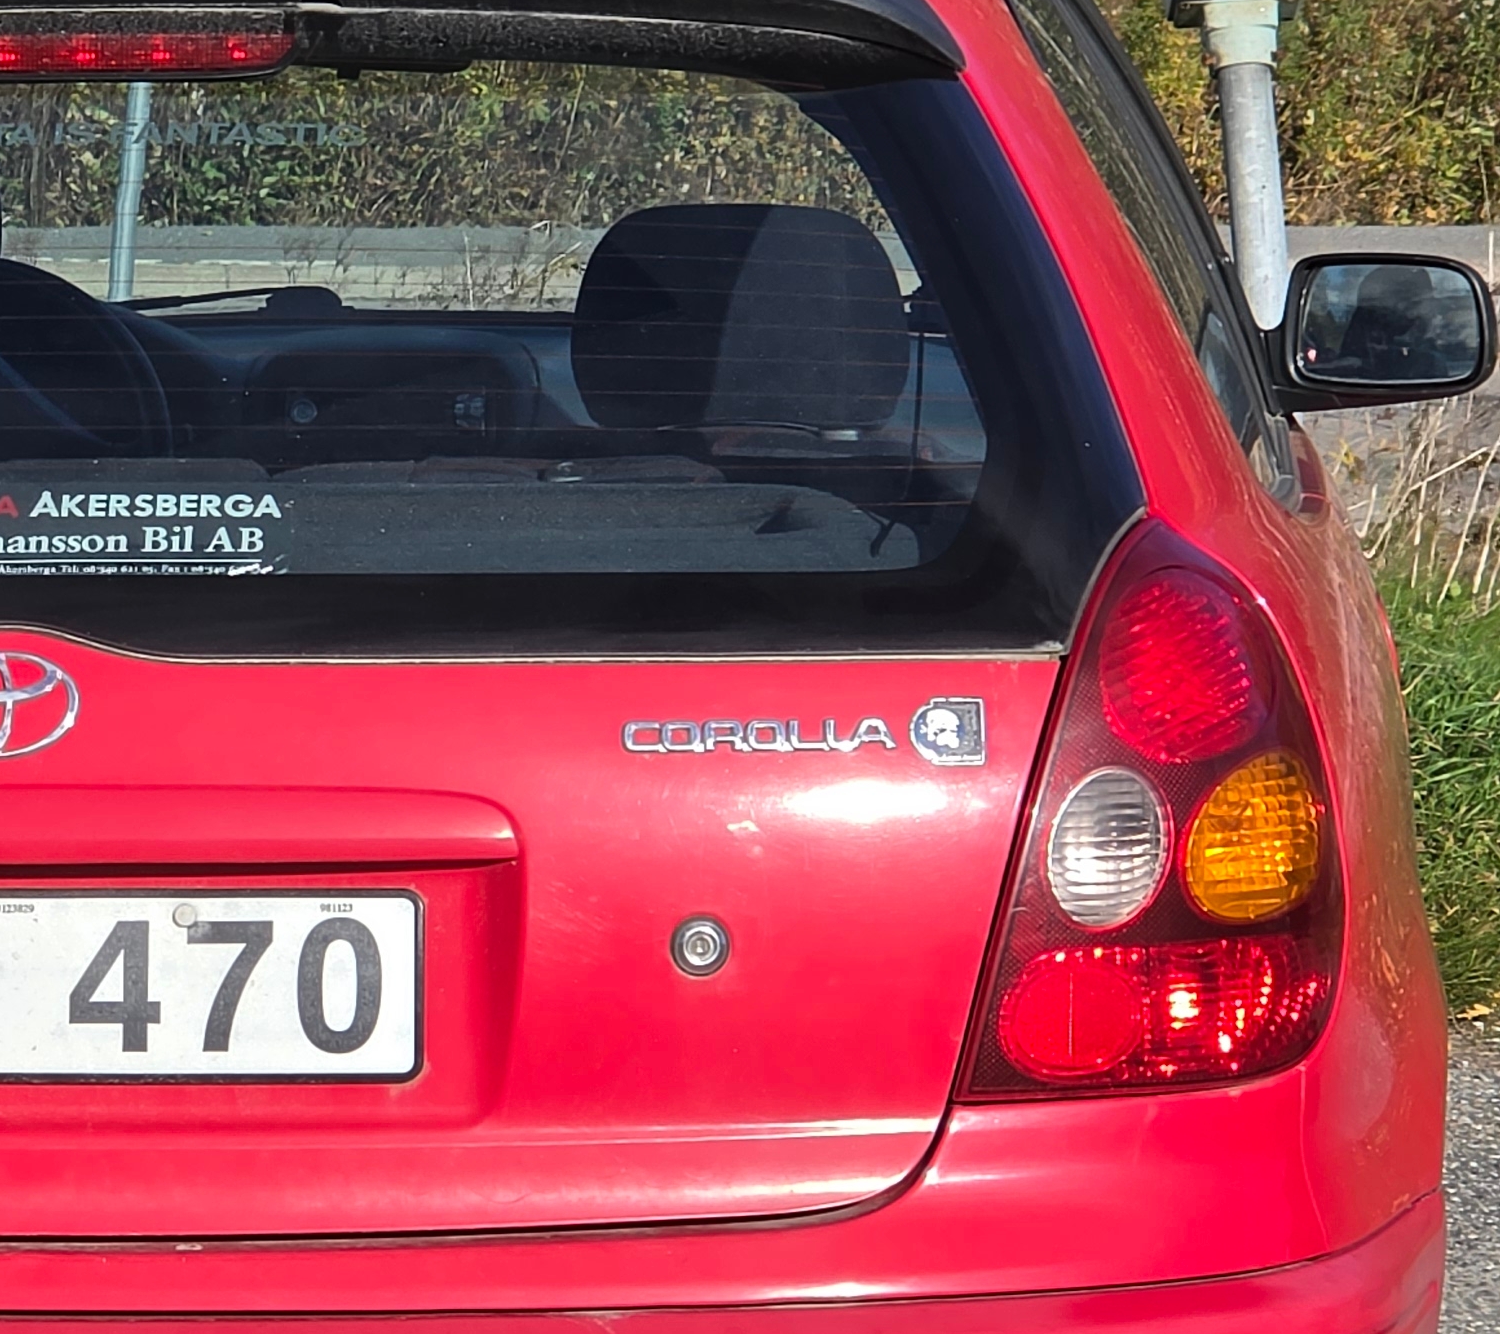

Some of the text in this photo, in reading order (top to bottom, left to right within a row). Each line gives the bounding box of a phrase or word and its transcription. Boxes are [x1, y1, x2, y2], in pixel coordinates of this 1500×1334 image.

[53, 122, 97, 145] IS
[109, 121, 367, 147] FANTASTIC
[141, 525, 194, 552] Bil
[203, 526, 264, 552] AB
[622, 717, 897, 753] COROLLA
[69, 917, 382, 1054] 470
